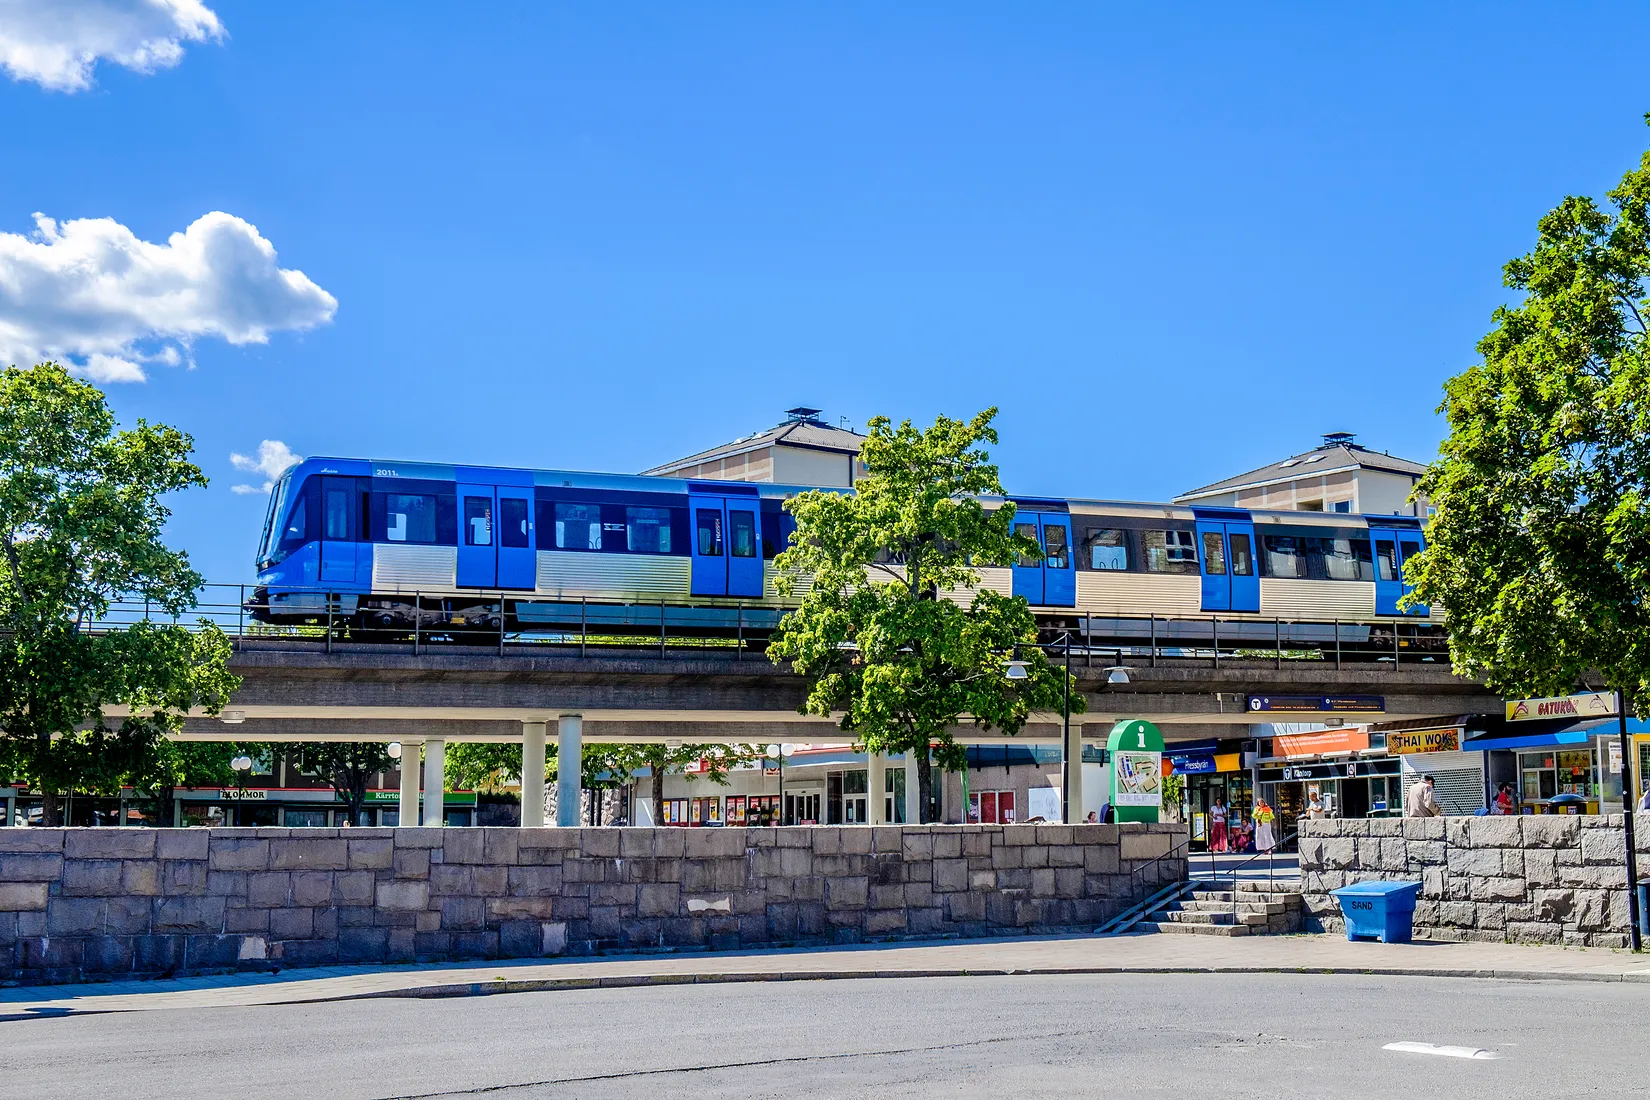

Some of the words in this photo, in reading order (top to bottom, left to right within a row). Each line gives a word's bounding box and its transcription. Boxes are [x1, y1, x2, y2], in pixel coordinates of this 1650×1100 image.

[1537, 698, 1579, 715] GATUKÖK
[1137, 725, 1146, 748] i
[1397, 734, 1421, 748] THAI
[1425, 733, 1449, 746] WOK
[1184, 760, 1209, 770] Pressbyrån
[222, 791, 265, 799] BLOMMOR
[1351, 900, 1373, 910] SAND
